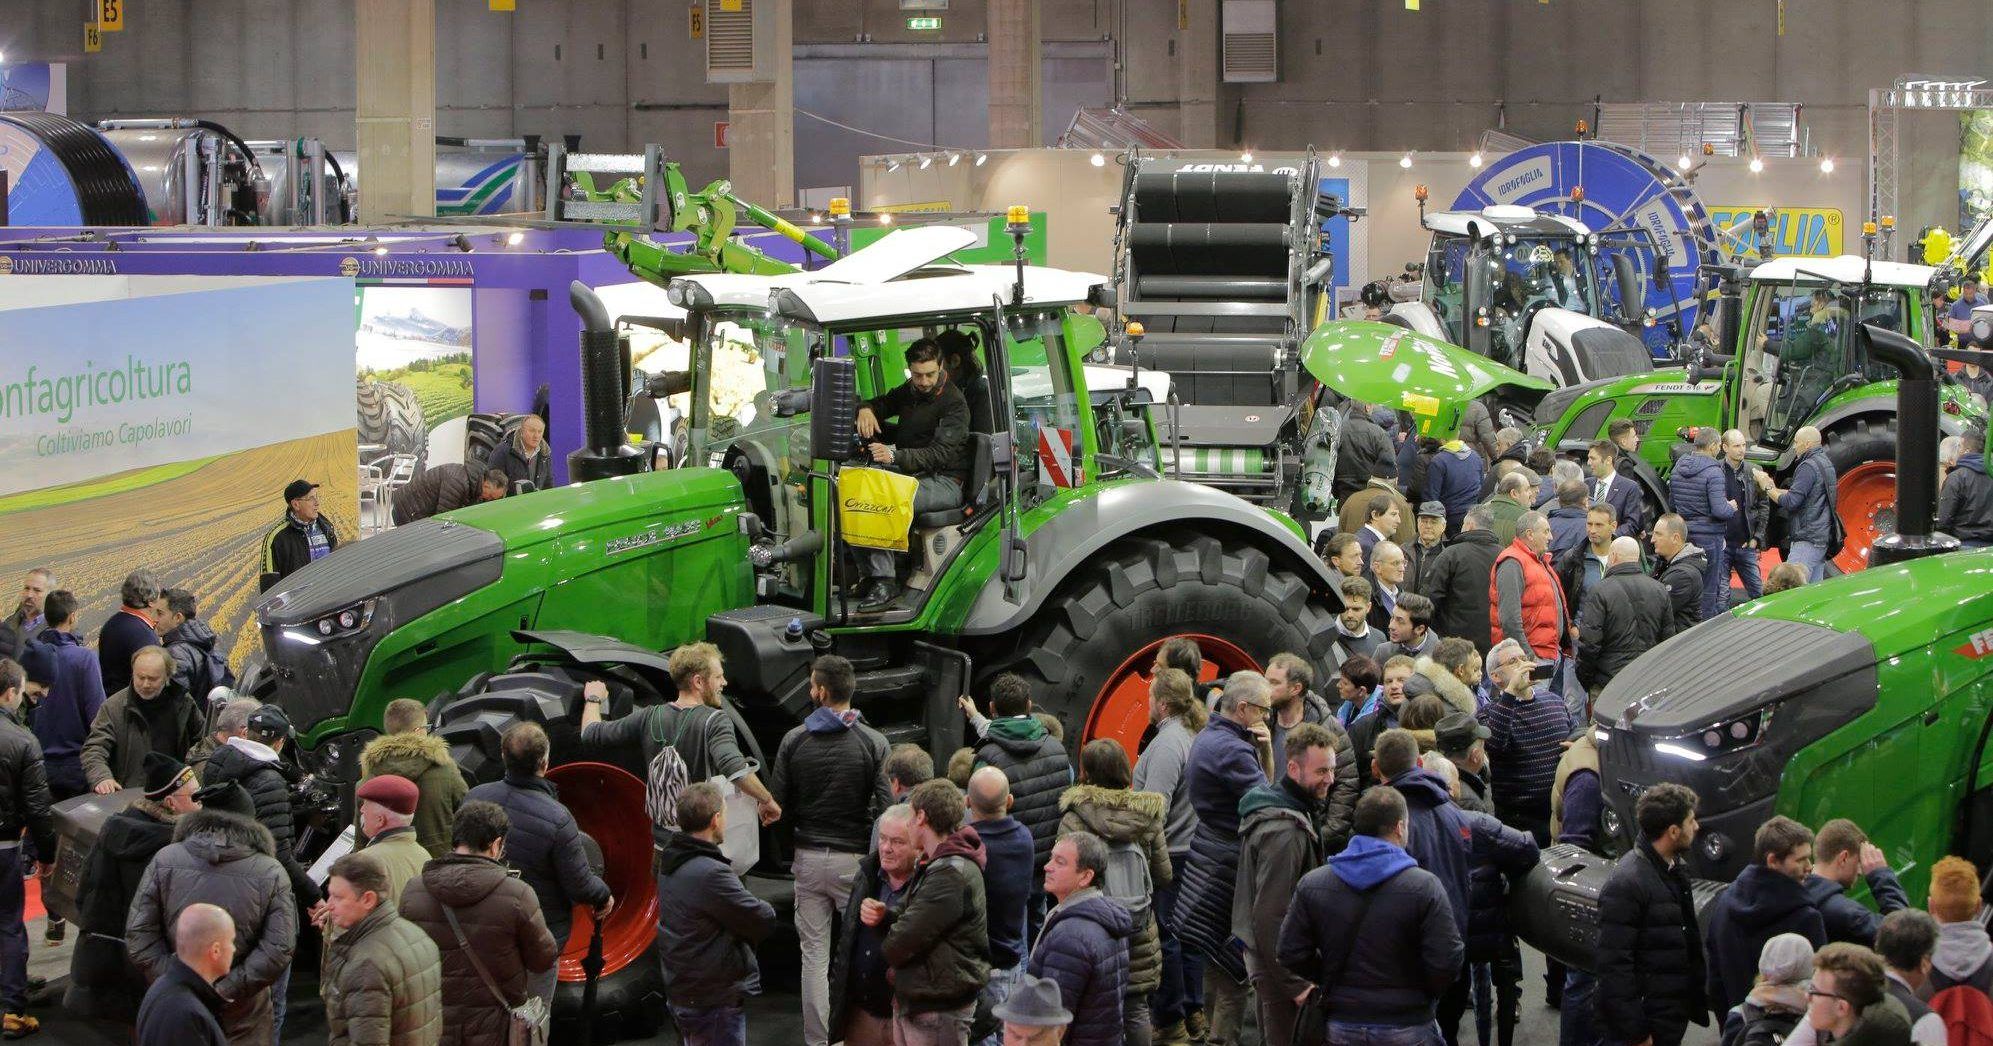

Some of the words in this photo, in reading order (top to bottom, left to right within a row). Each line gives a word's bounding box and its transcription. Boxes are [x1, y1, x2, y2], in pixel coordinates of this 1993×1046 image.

[104, 0, 117, 22] E5
[692, 14, 701, 31] F5
[88, 29, 98, 46] F6
[1497, 168, 1543, 196] IDROFOGLIA
[15, 259, 117, 274] UNIVERGOMMA
[361, 260, 474, 275] UNIVERGOMMA
[0, 355, 192, 424] nfagricoltura
[37, 429, 114, 457] Coltiviamo
[118, 411, 192, 448] Capolavori
